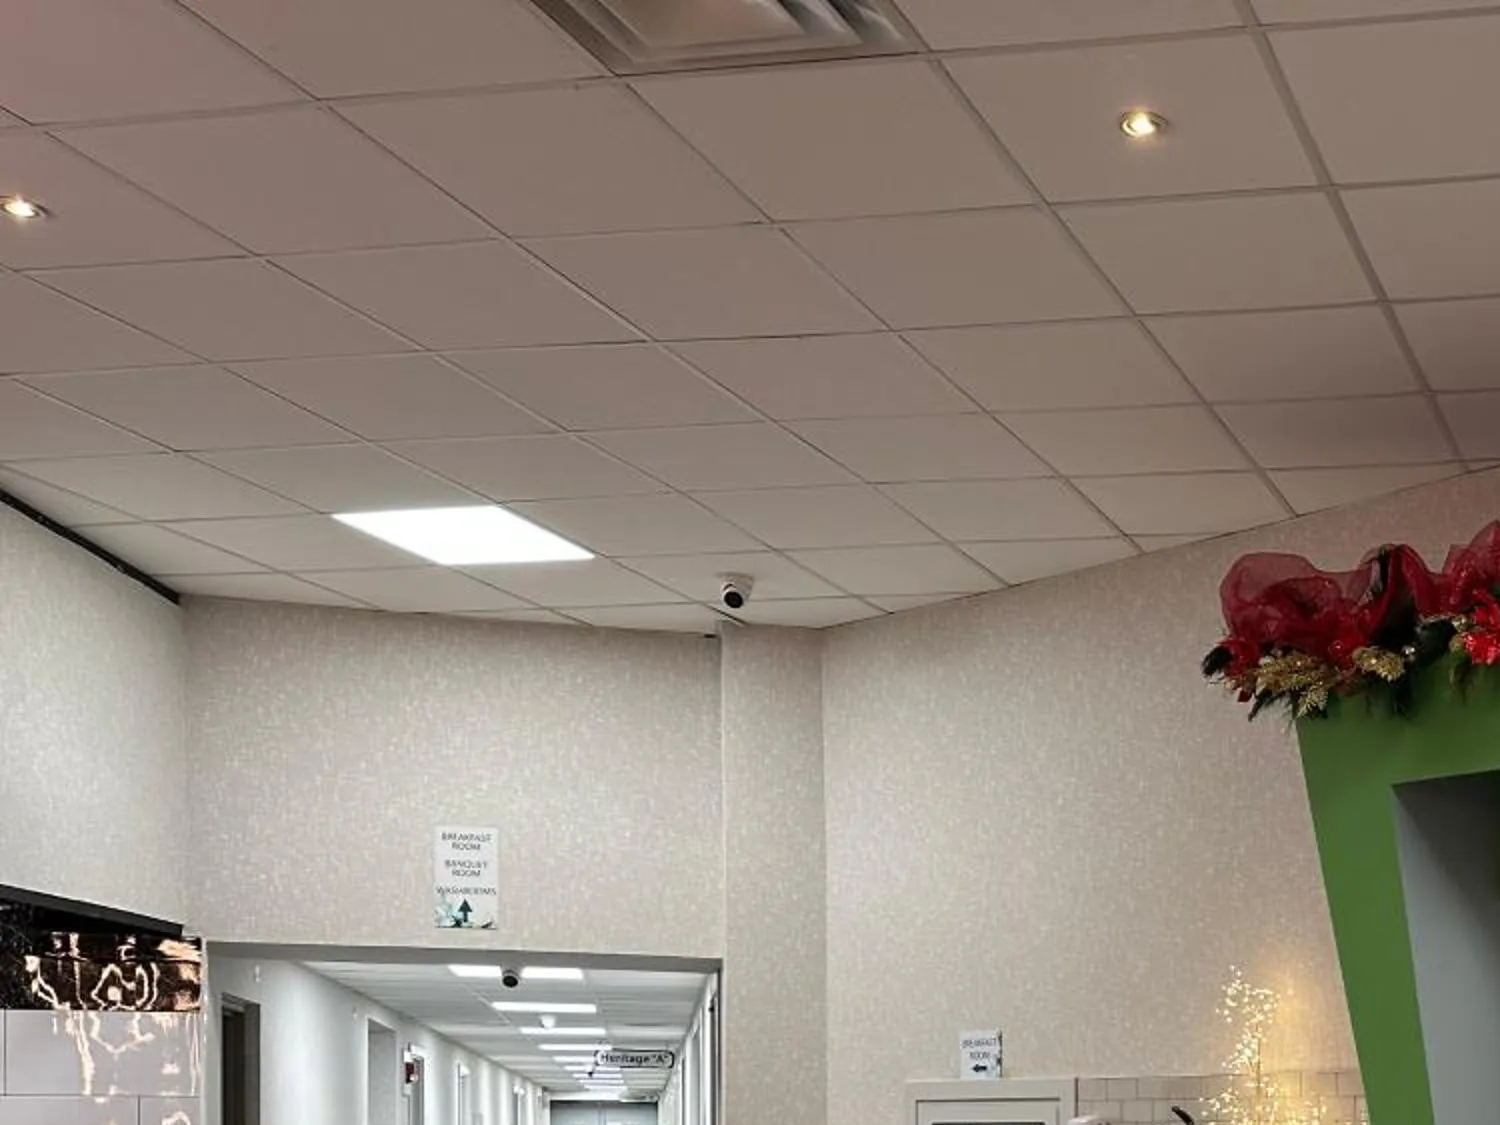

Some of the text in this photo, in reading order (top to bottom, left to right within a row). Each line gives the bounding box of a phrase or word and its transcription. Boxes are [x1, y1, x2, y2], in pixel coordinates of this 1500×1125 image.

[441, 832, 493, 842] BREAKFAST
[451, 842, 481, 851] ROOM
[451, 869, 481, 877] ROOM
[601, 1053, 651, 1066] Heritage
